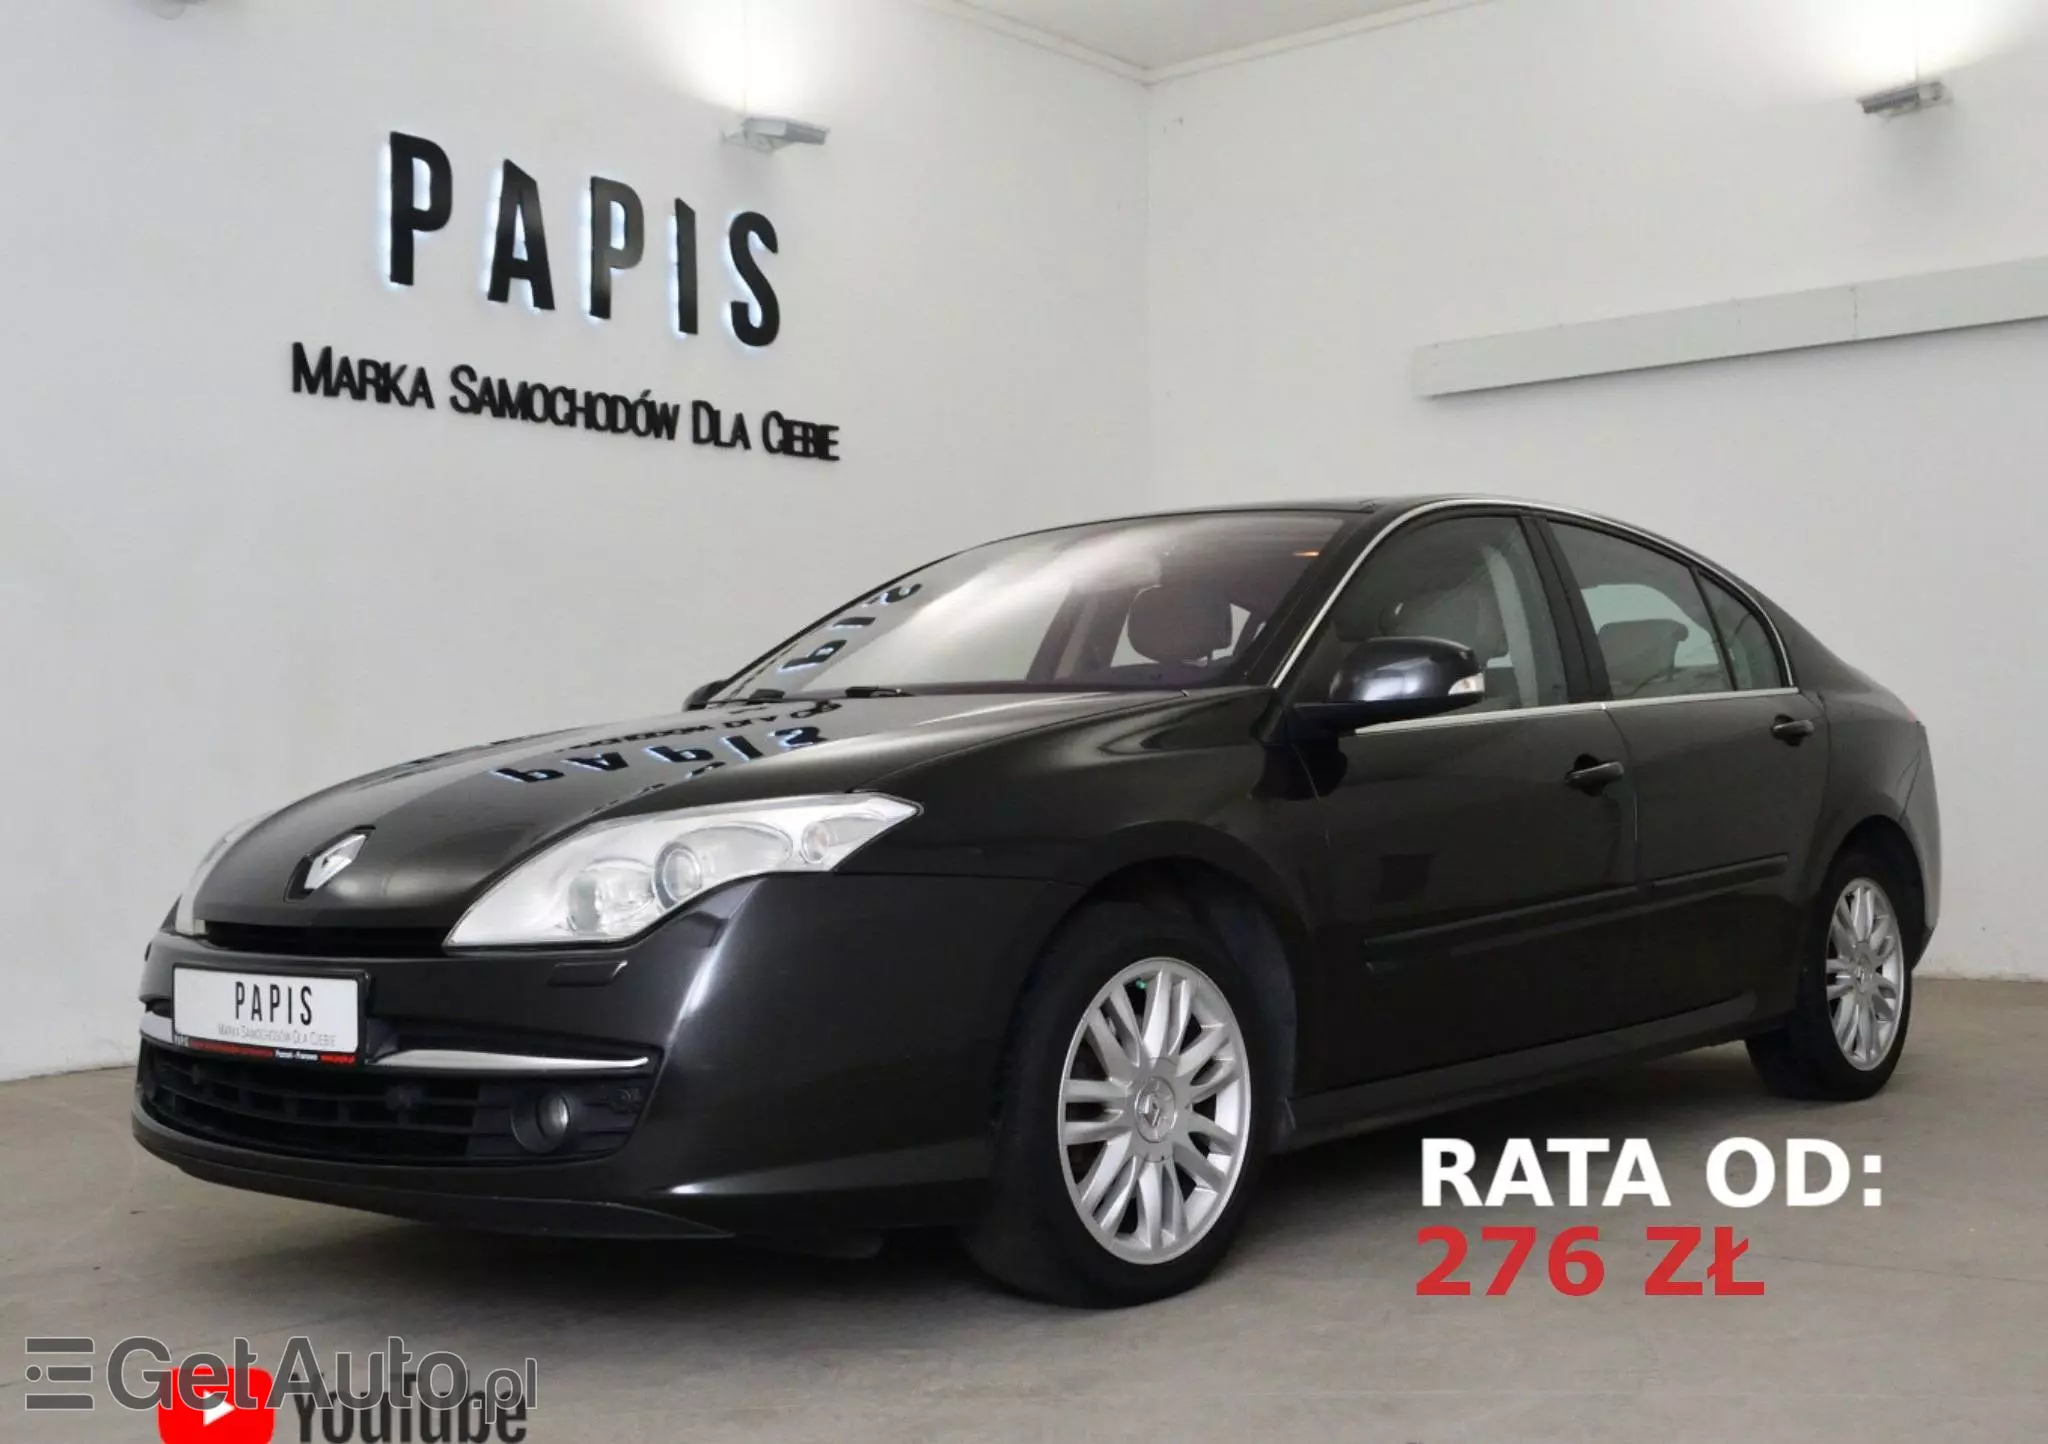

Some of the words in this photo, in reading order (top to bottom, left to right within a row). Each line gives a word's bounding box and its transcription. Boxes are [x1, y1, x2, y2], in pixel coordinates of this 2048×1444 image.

[389, 131, 781, 347] PAPIS
[292, 342, 434, 409] MARKA
[450, 365, 680, 440] SAMOCHODÓW
[692, 400, 751, 451] DLA
[235, 981, 313, 1026] PAPIS
